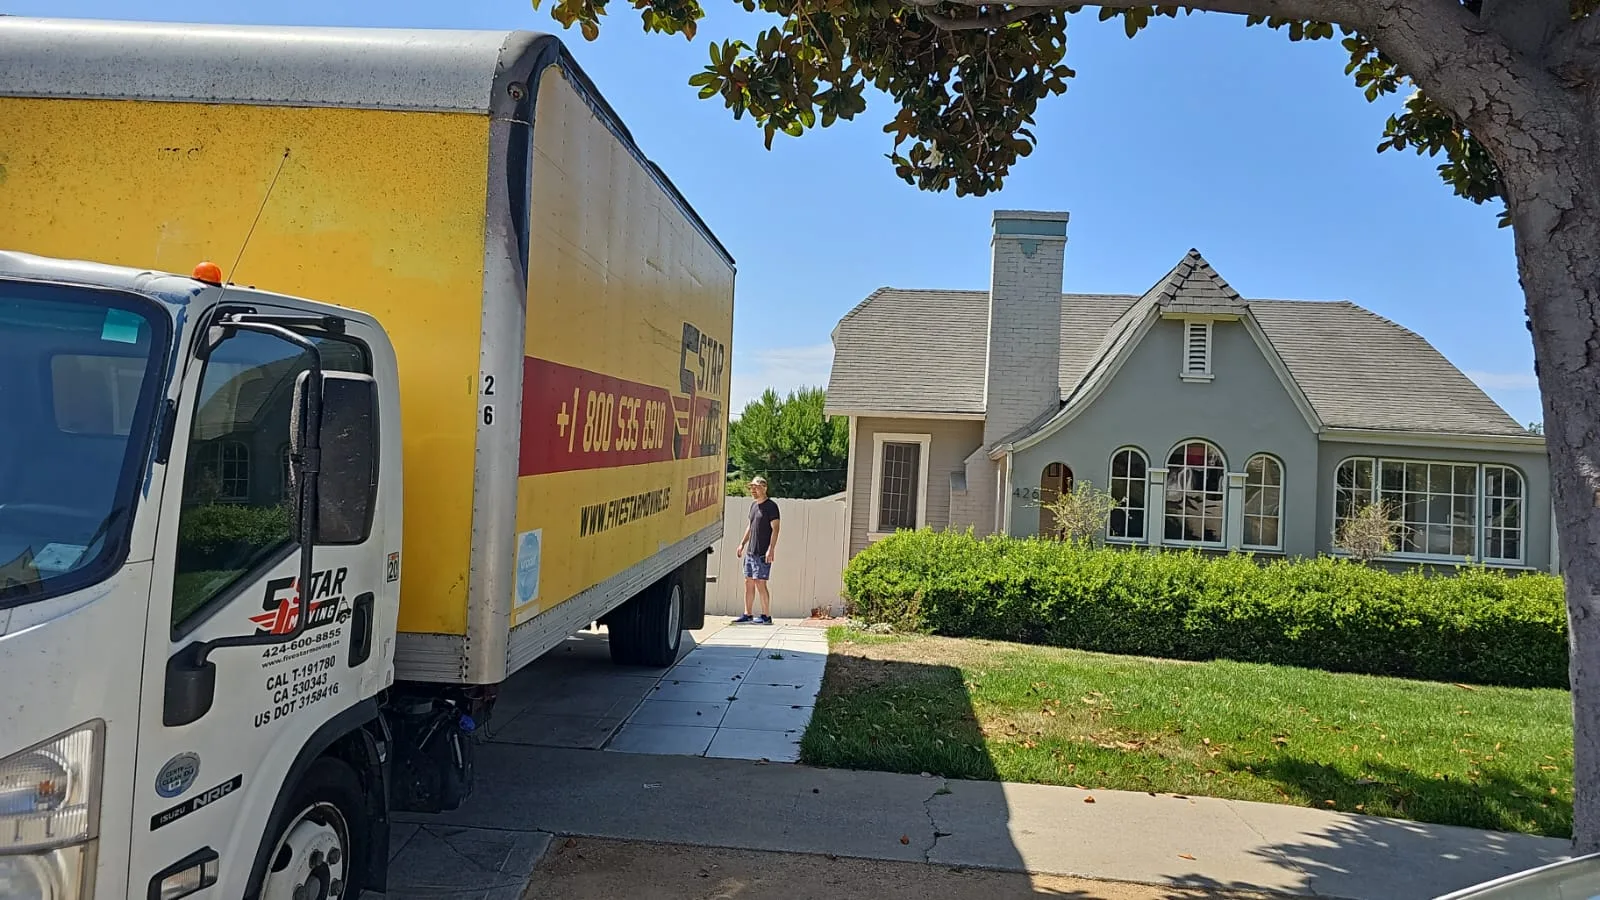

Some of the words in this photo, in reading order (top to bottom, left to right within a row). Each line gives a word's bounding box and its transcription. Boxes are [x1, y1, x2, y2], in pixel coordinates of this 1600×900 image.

[697, 333, 725, 396] STAR
[484, 375, 494, 395] 2
[483, 405, 493, 425] 6
[582, 390, 615, 453] 800
[615, 395, 641, 451] 535
[641, 400, 666, 450] 8910
[1012, 487, 1039, 499] 426
[293, 566, 348, 604] TAR
[287, 604, 335, 630] MVING
[261, 640, 340, 668] www.fivestarmoving.us
[262, 627, 342, 658] 424-600-8855
[266, 672, 289, 691] CAL
[291, 655, 336, 682] T-191780
[273, 687, 289, 704] CA
[291, 672, 328, 697] 530343
[254, 710, 271, 728] US
[273, 699, 297, 720] DOT
[298, 682, 339, 709] 3158416
[160, 806, 186, 824] ISUZU
[193, 780, 234, 810] NRR
